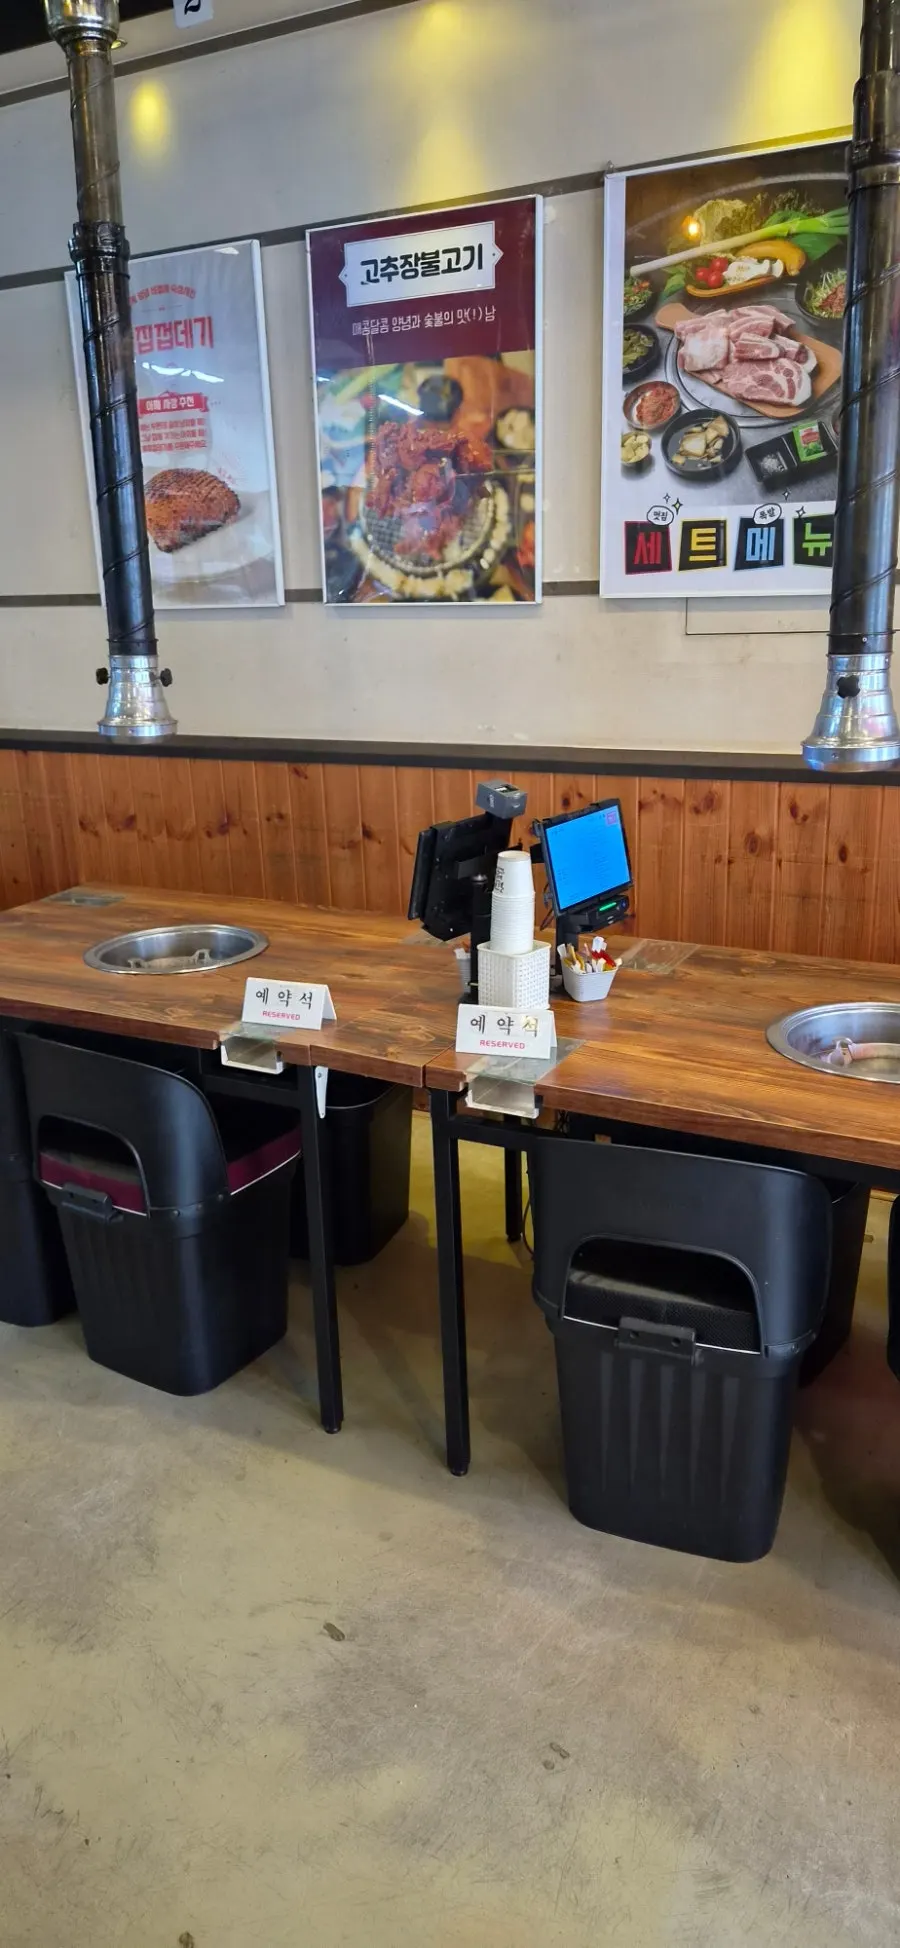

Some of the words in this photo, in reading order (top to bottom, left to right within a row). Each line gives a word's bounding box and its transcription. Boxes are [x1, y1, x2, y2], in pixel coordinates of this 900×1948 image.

[360, 243, 483, 286] 고추장불고기
[391, 315, 421, 332] 양념과
[424, 310, 454, 328] 숯불의
[262, 1010, 301, 1021] RESERVED
[479, 1039, 526, 1050] RESERVED
